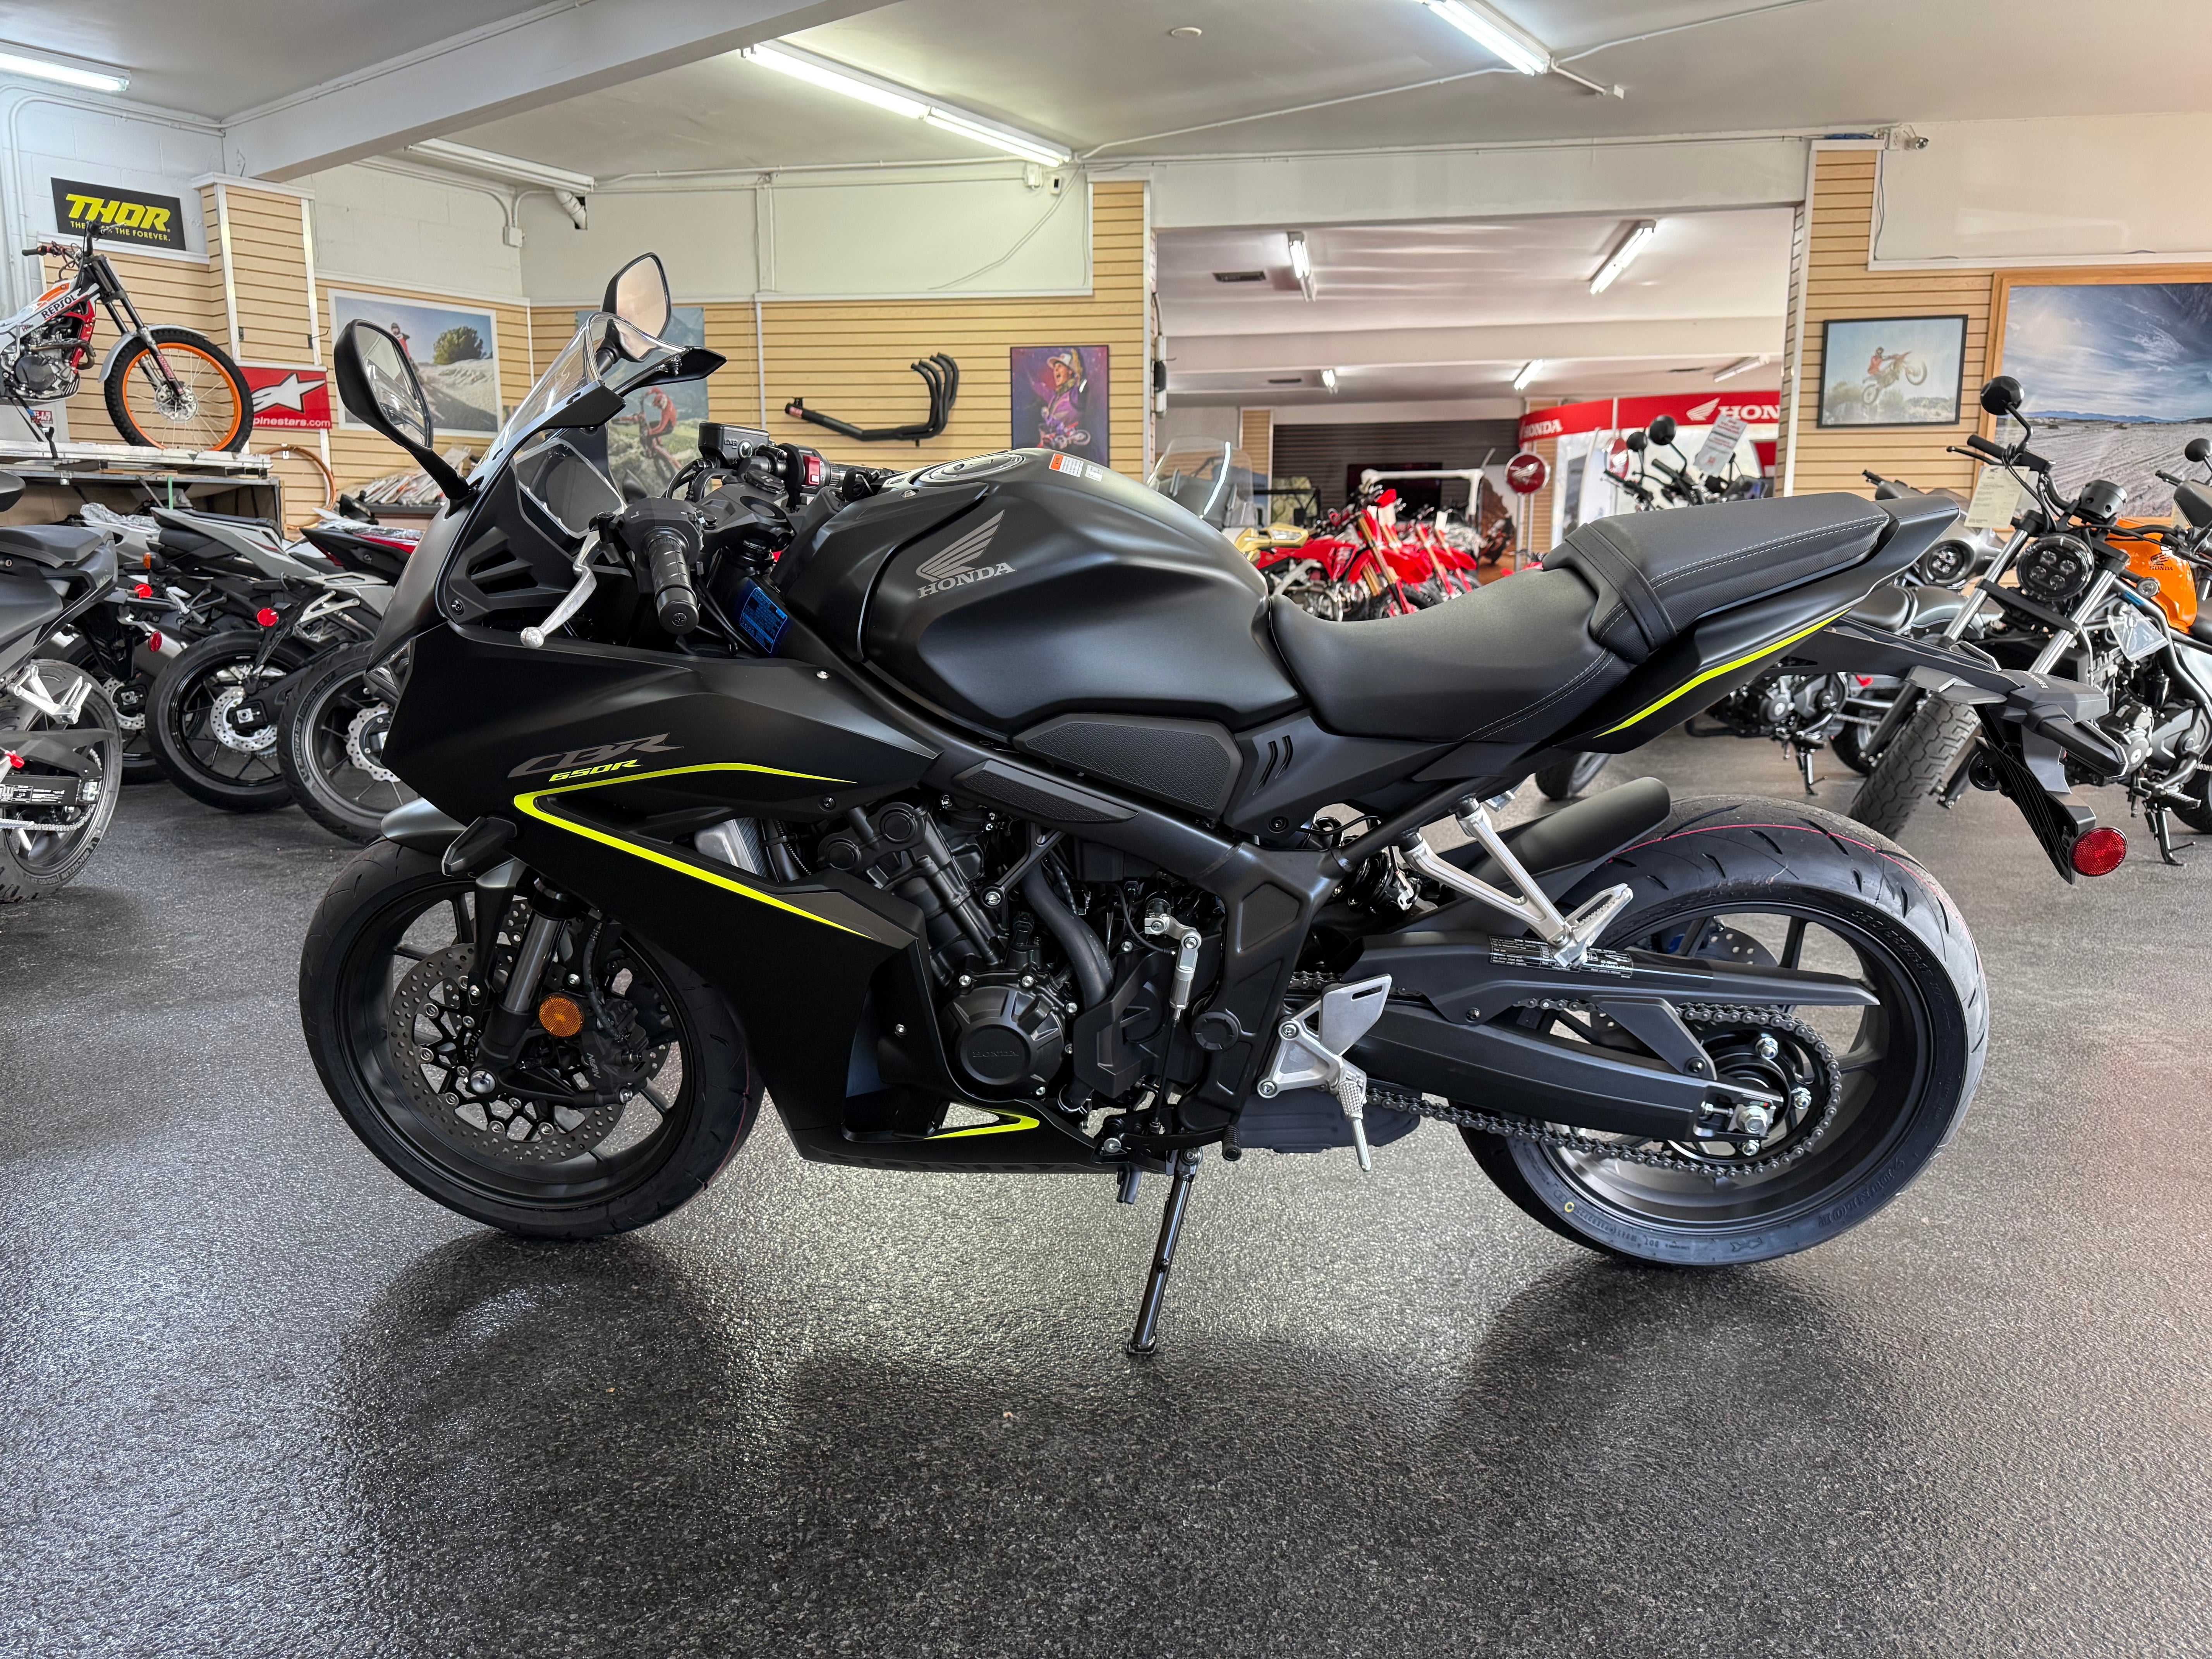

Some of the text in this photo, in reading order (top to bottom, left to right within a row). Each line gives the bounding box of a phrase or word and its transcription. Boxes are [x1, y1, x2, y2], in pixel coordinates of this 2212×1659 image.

[65, 194, 169, 232] THOR
[70, 221, 86, 229] THE
[115, 227, 130, 236] THE
[132, 229, 170, 242] FOREVER.
[41, 294, 77, 319] REPSOL
[917, 562, 1017, 599] HONDA
[507, 732, 683, 778] CBR
[549, 759, 643, 782] 650R
[61, 849, 90, 880] MICHELIN
